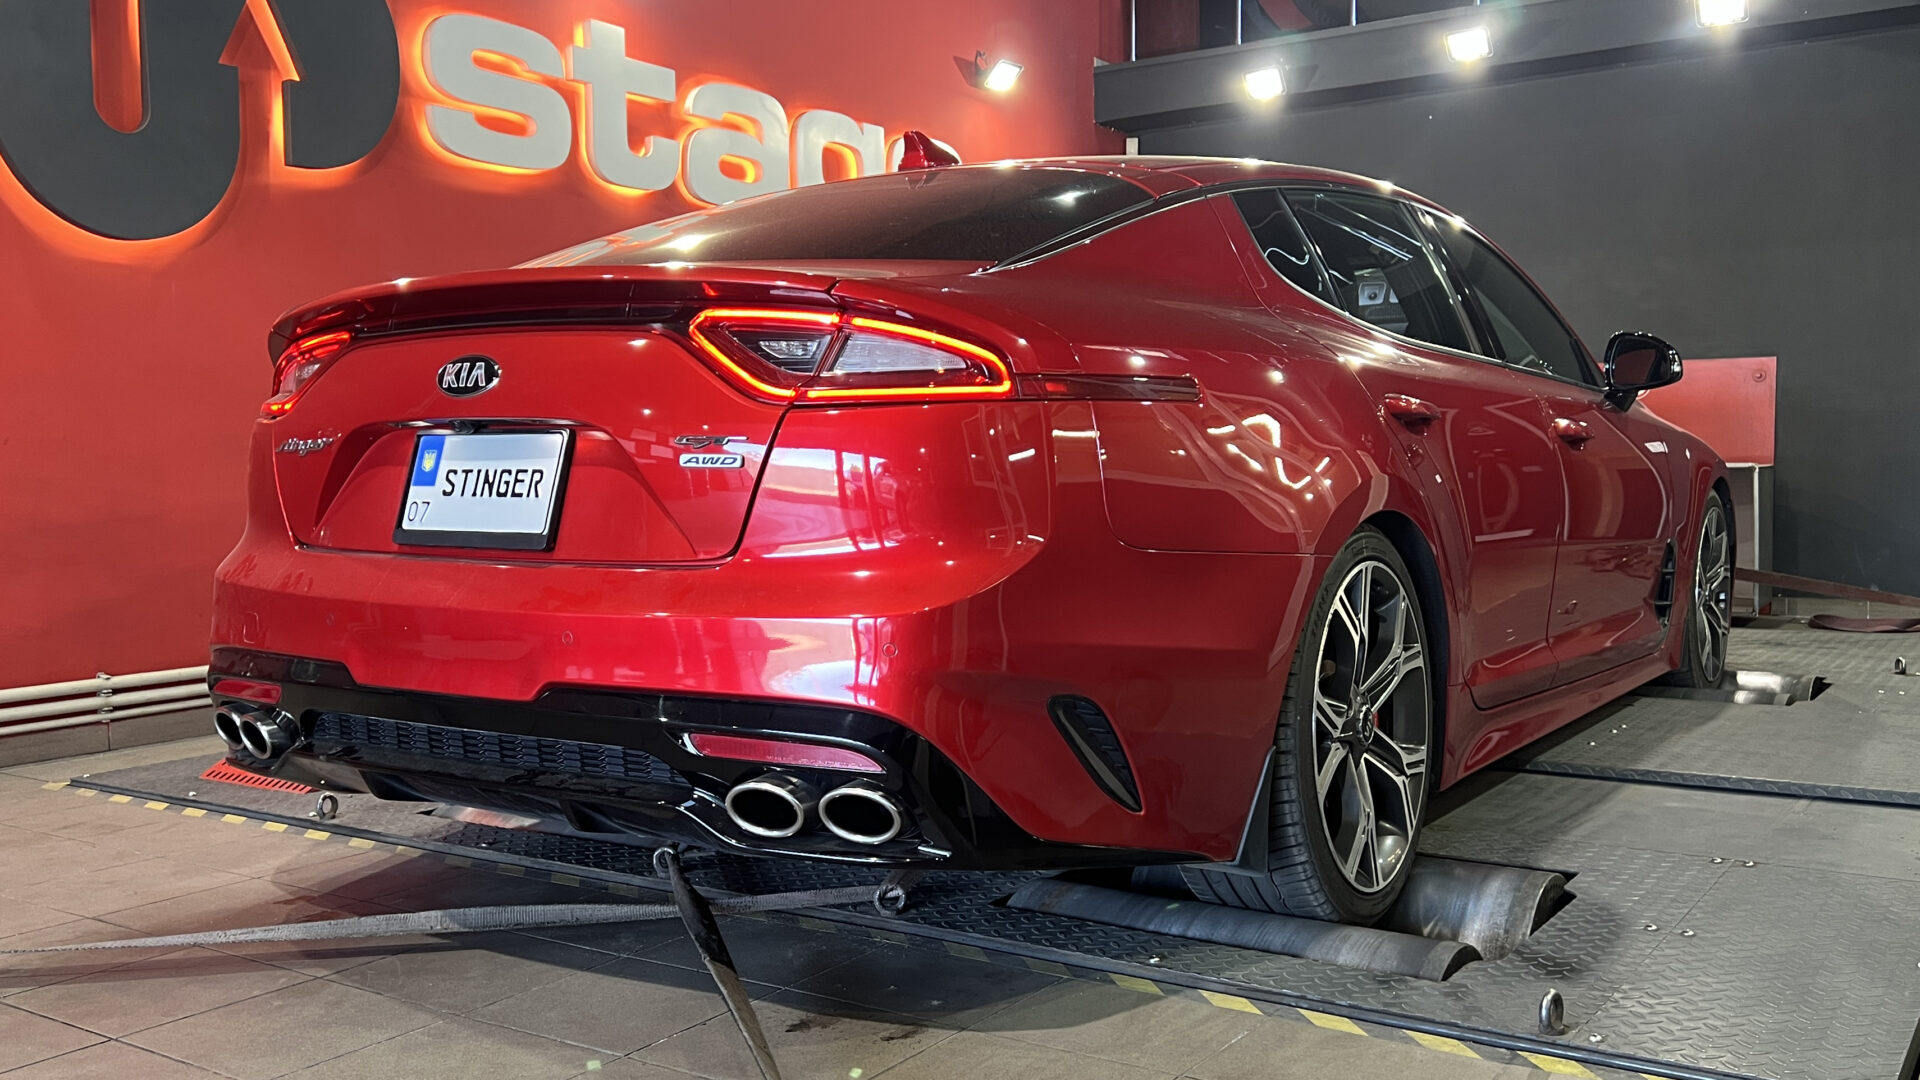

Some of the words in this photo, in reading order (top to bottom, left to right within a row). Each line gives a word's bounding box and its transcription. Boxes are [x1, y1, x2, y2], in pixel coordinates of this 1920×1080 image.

[442, 361, 486, 388] KIA
[682, 456, 738, 465] AWD
[442, 468, 544, 498] STINGER
[407, 501, 431, 523] 07
